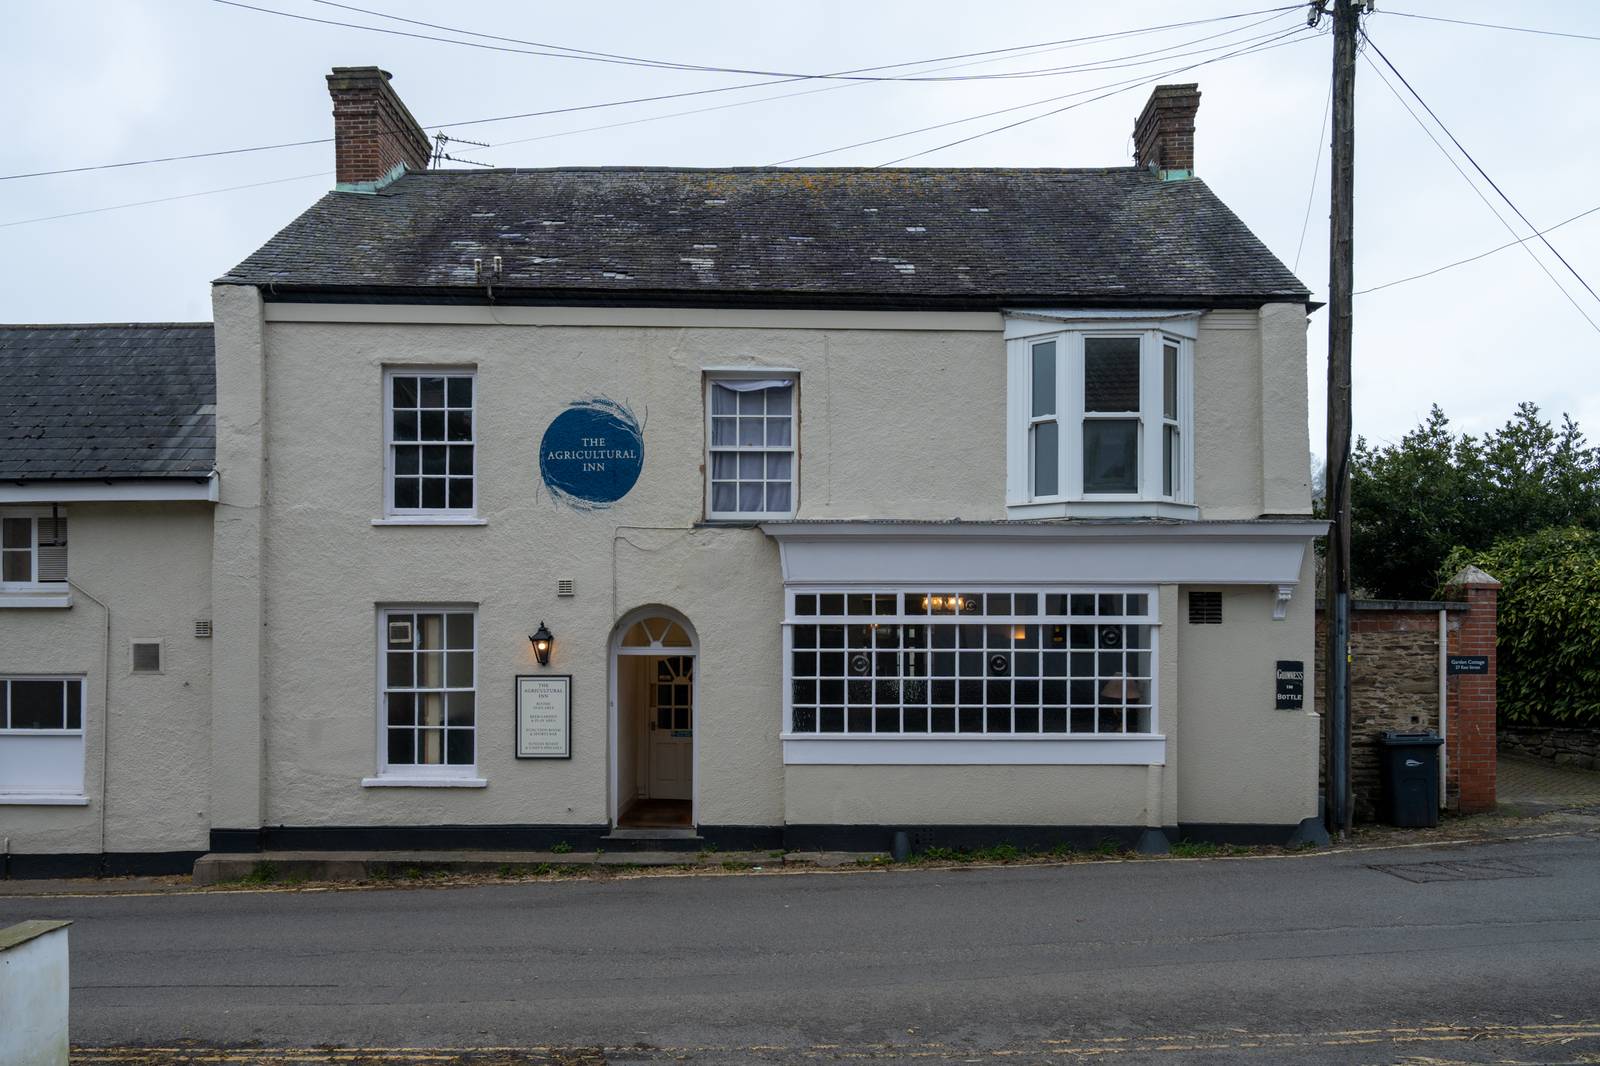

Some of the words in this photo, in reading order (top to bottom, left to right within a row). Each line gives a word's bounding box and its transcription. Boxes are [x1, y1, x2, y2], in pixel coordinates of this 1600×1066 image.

[581, 438, 606, 447] THE
[547, 450, 637, 460] AGRICULTURAL
[583, 463, 605, 471] INN
